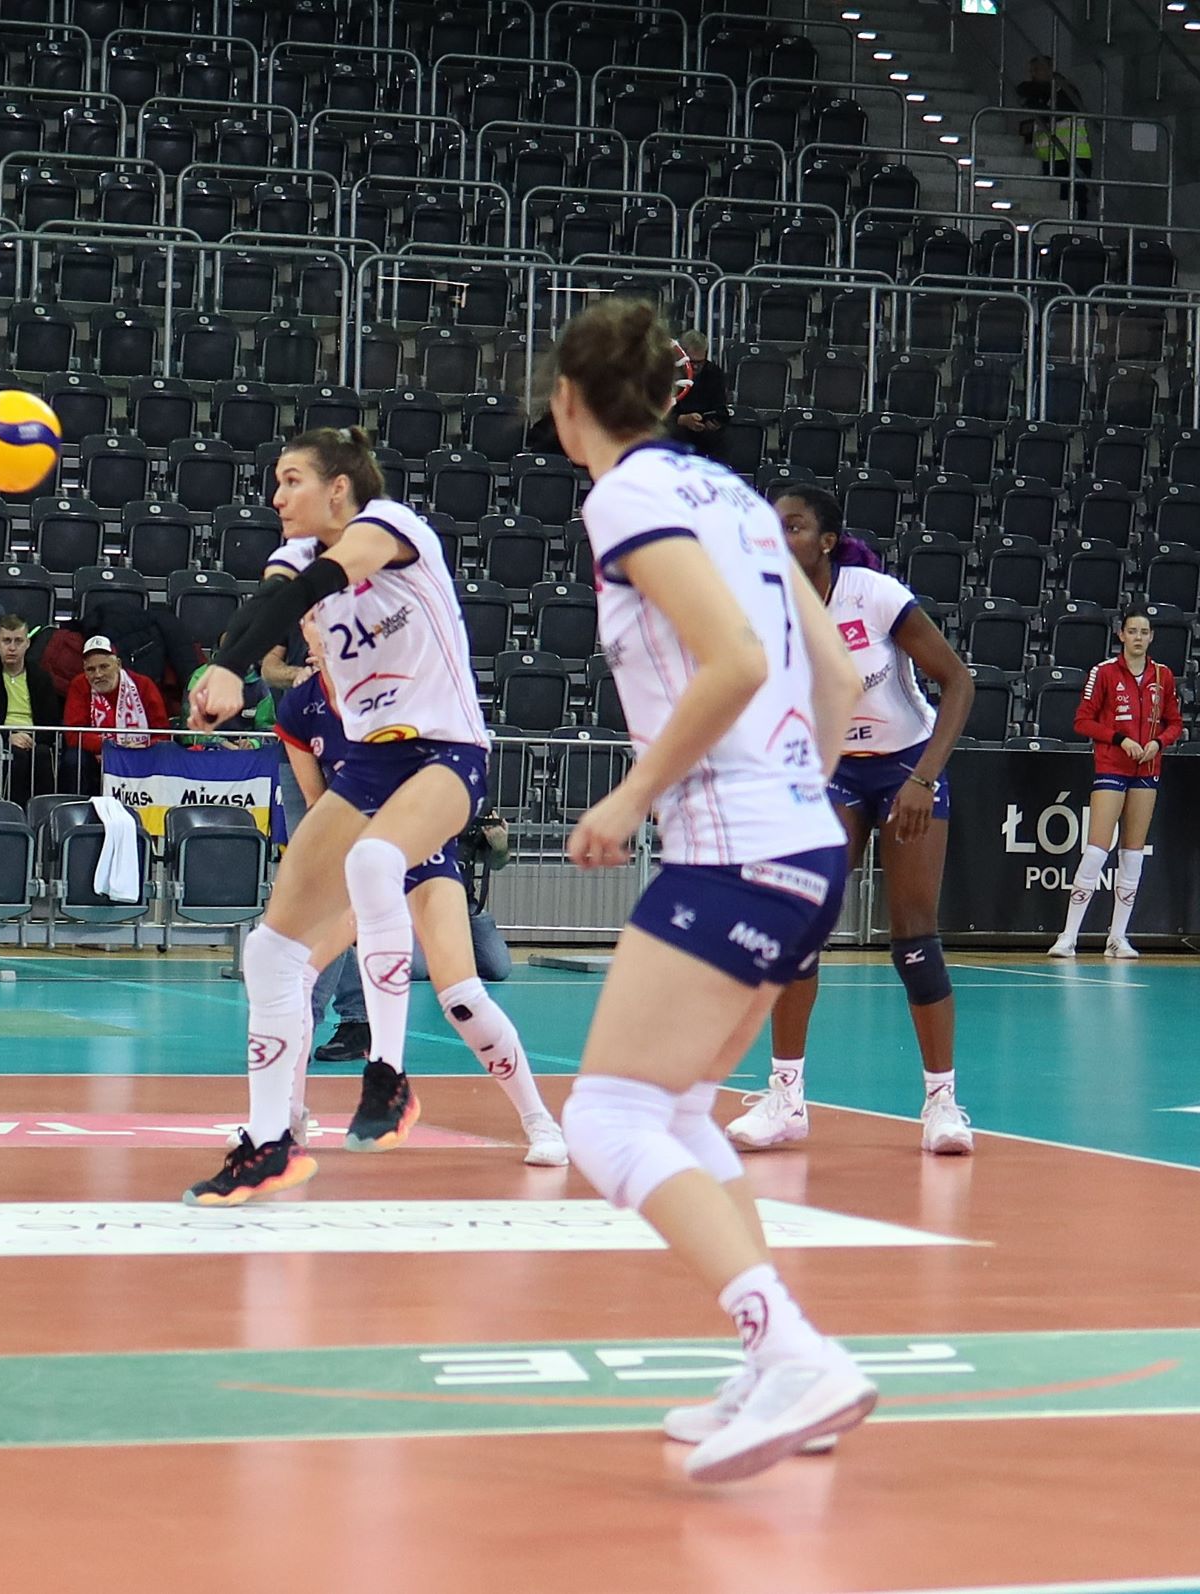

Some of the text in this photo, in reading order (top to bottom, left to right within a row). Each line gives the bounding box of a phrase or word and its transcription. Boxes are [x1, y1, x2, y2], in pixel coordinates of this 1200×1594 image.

[329, 614, 377, 660] 24
[762, 573, 792, 670] 7
[181, 786, 255, 806] MIKASA
[1001, 791, 1153, 856] ŁÓ
[1025, 866, 1119, 891] POLN
[15, 1219, 642, 1232] awendowe
[419, 1343, 977, 1386] PGE
